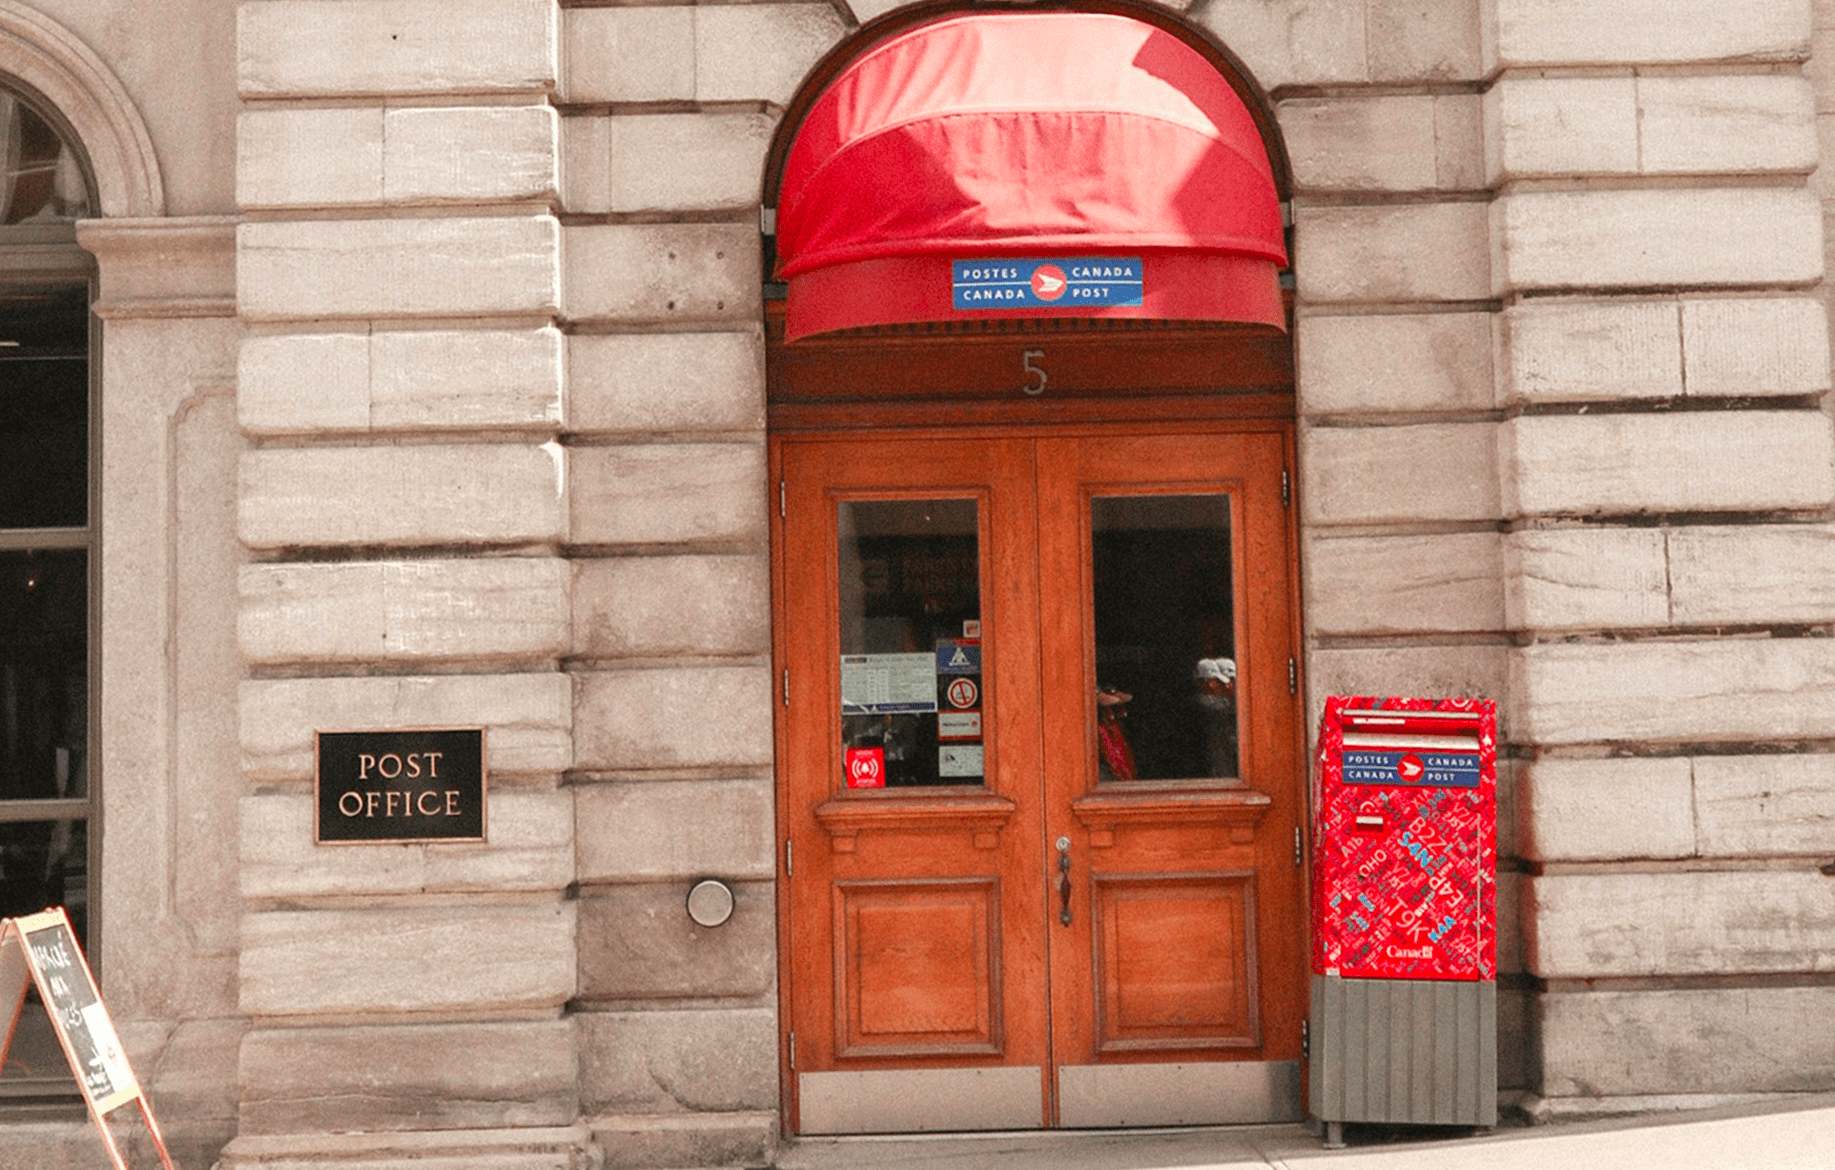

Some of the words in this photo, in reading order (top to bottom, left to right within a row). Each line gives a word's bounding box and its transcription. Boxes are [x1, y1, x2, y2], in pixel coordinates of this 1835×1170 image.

[962, 267, 1018, 280] POSTES
[1072, 266, 1133, 278] CANADA
[963, 288, 1026, 301] CANADA
[1072, 287, 1110, 298] POST
[1022, 348, 1048, 396] 5
[358, 752, 443, 780] POST
[1348, 755, 1389, 765] POSTES
[1427, 757, 1474, 767] CANADA
[1348, 771, 1394, 780] CANADA
[1428, 773, 1455, 781] POST
[338, 789, 462, 818] OFFICE
[1396, 831, 1434, 868] S4N
[1408, 816, 1447, 856] B2Z
[1429, 876, 1464, 908] E4P
[1388, 896, 1430, 945] T9K
[1428, 916, 1456, 944] K4A
